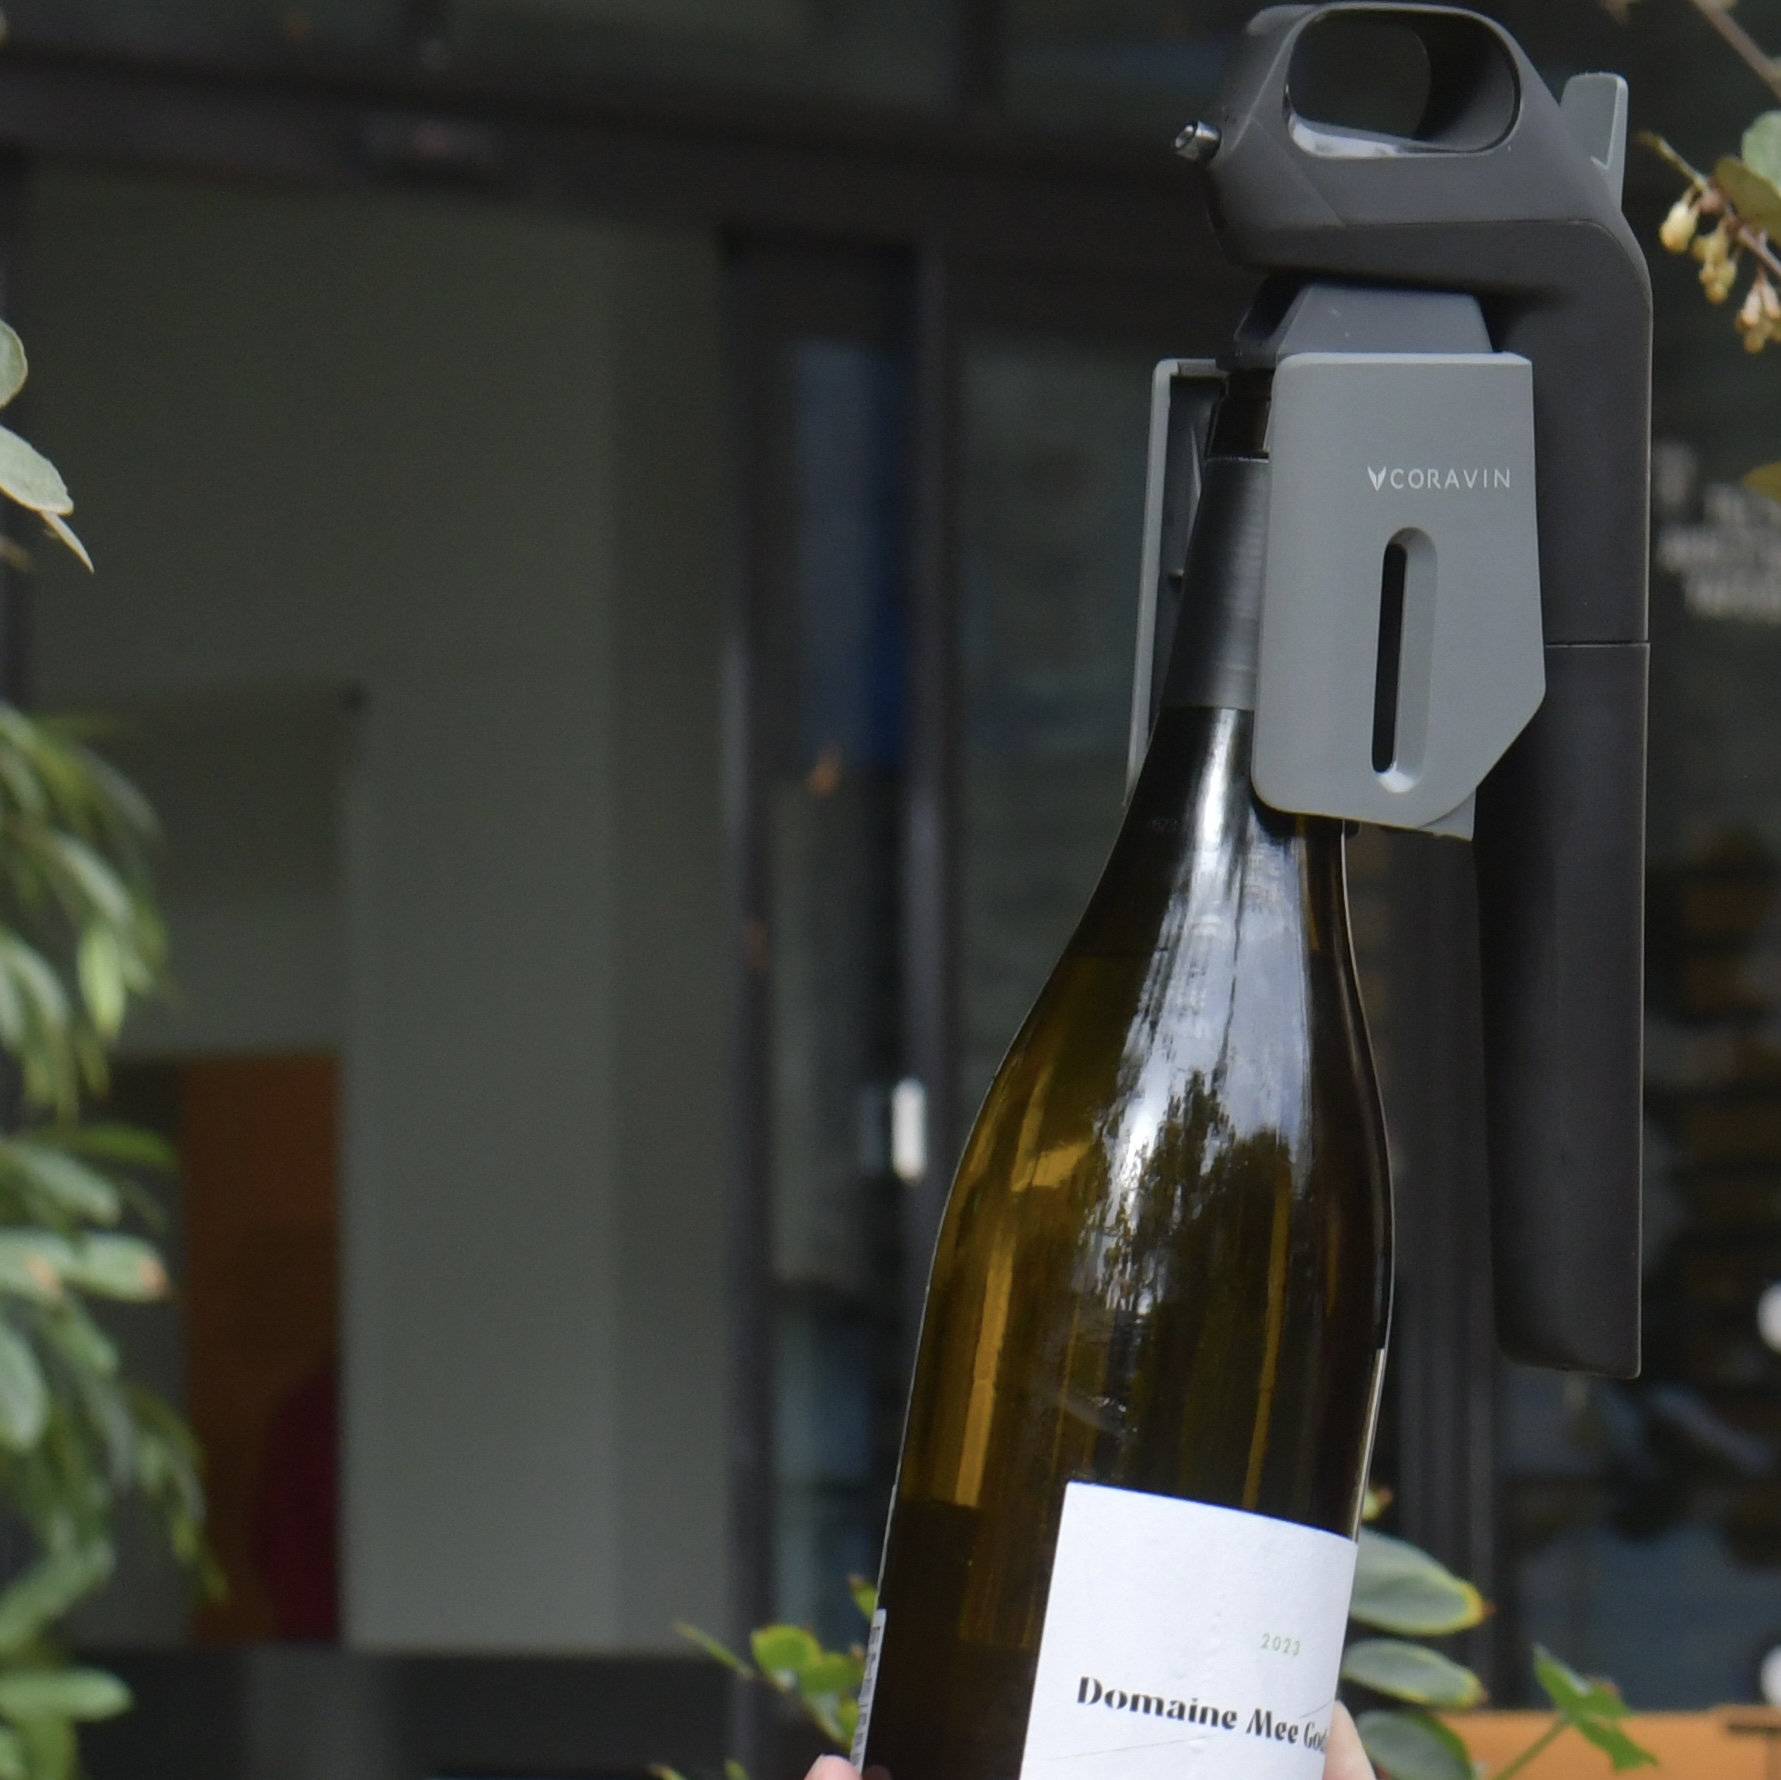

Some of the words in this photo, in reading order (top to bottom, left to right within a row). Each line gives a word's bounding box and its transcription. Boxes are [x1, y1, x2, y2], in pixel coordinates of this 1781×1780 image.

[1261, 1632, 1301, 1656] 2023
[1076, 1676, 1238, 1730] Domaine
[1246, 1708, 1299, 1744] Mee
